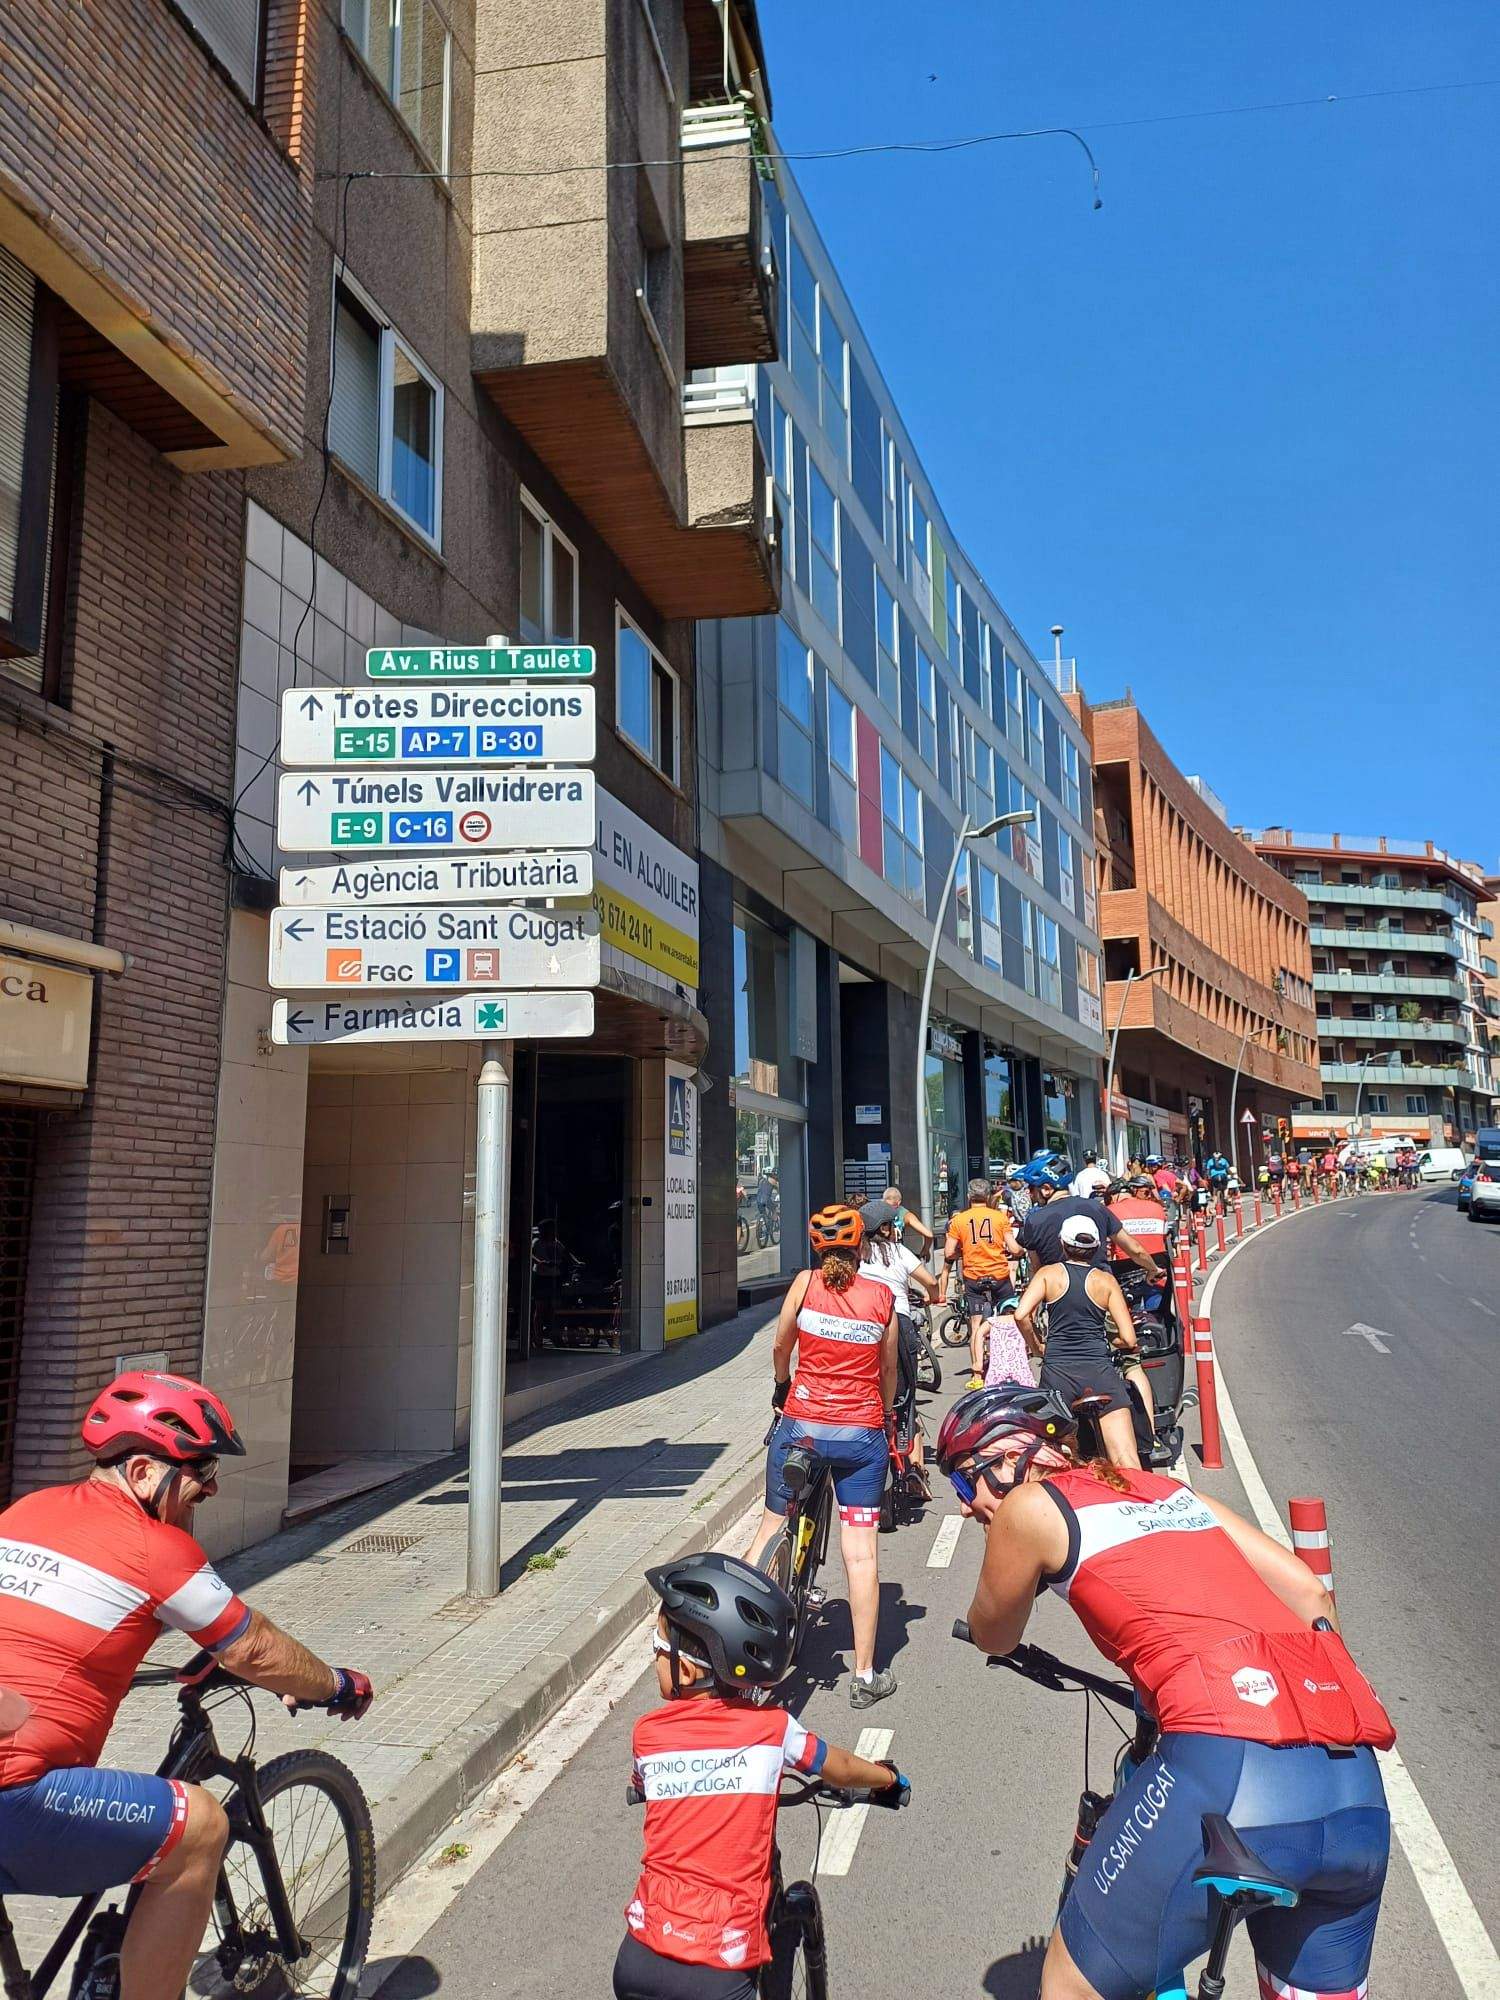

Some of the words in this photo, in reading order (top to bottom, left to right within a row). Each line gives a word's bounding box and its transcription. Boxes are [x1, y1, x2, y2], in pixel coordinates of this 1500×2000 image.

[380, 650, 419, 671] Av.
[430, 650, 479, 670] Rius
[490, 650, 496, 670] i
[507, 649, 581, 669] Taulet
[334, 692, 419, 718] Totes
[431, 691, 582, 718] Direccions
[339, 732, 390, 753] E-15
[408, 731, 464, 752] AP-7
[482, 730, 537, 752] B-30
[332, 777, 424, 804] Túnels
[436, 776, 583, 803] Vallvidrera
[337, 818, 377, 839] E-9
[395, 817, 447, 838] C-16
[331, 864, 439, 899] Agència
[451, 858, 579, 889] Tributària
[613, 830, 632, 874] EN
[637, 850, 697, 918] ALQUILER
[326, 911, 427, 940] Estació
[437, 911, 498, 940] Sant
[508, 912, 585, 947] Cugat
[608, 902, 626, 936] 674
[628, 915, 640, 944] 24
[642, 923, 653, 950] 01
[367, 965, 413, 982] FGC
[324, 1000, 462, 1031] Farmàcia
[667, 1177, 686, 1194] LOCAL
[688, 1179, 695, 1194] EN
[667, 1203, 695, 1220] ALQUILER
[968, 1218, 992, 1244] 14
[820, 1328, 841, 1339] SANT
[843, 1333, 871, 1343] CUGAT
[691, 1754, 748, 1773] CICLISTA
[657, 1781, 690, 1796] SANT
[694, 1777, 742, 1793] CUGAT
[1134, 1762, 1176, 1830] CUGAT
[44, 1788, 67, 1813] U.C.
[69, 1794, 105, 1819] SANT
[106, 1800, 156, 1824] CUGAT
